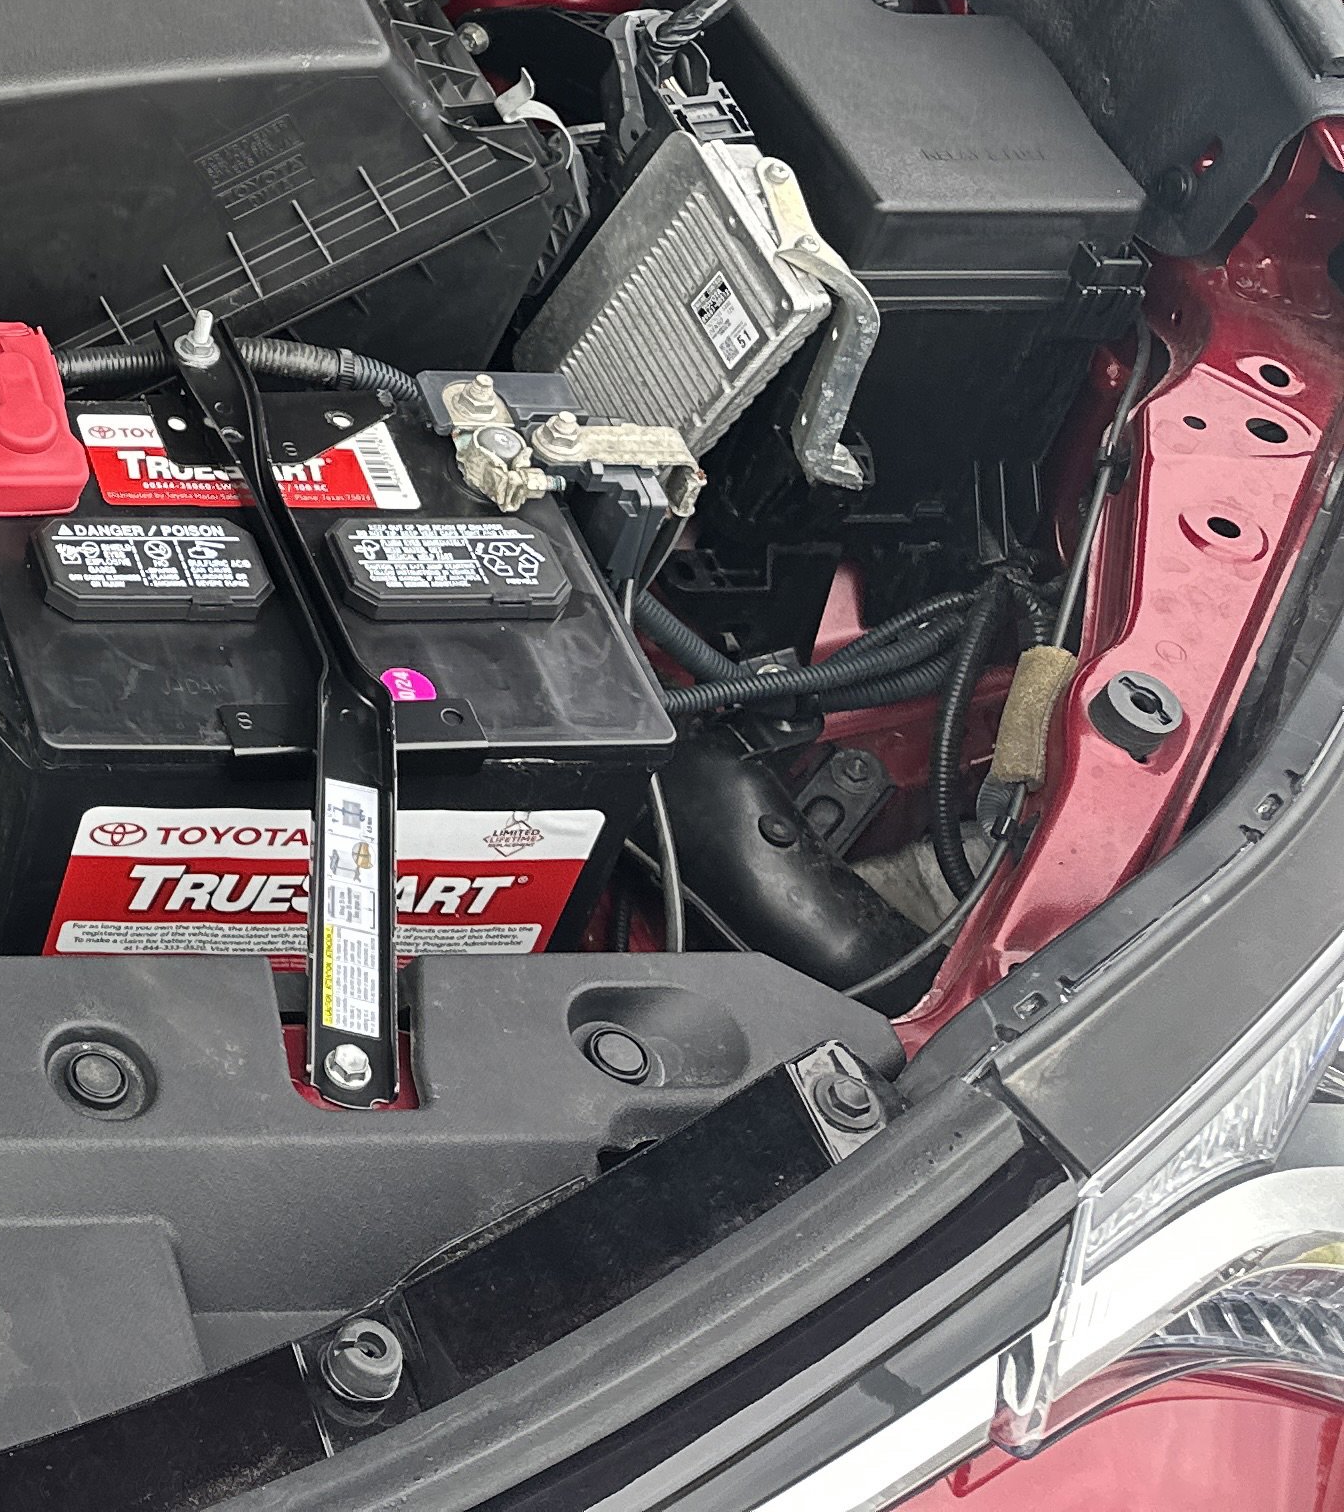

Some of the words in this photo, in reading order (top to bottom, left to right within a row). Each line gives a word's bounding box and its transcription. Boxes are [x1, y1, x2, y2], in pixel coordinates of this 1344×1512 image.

[736, 329, 752, 349] 51
[116, 449, 326, 482] TRUEART
[73, 524, 145, 536] DANGER
[160, 525, 226, 537] POISON
[157, 826, 309, 846] TOYOTA
[493, 829, 541, 837] LIMITED
[127, 864, 516, 914] TRUEART
[100, 922, 122, 931] long
[160, 937, 192, 945] battery
